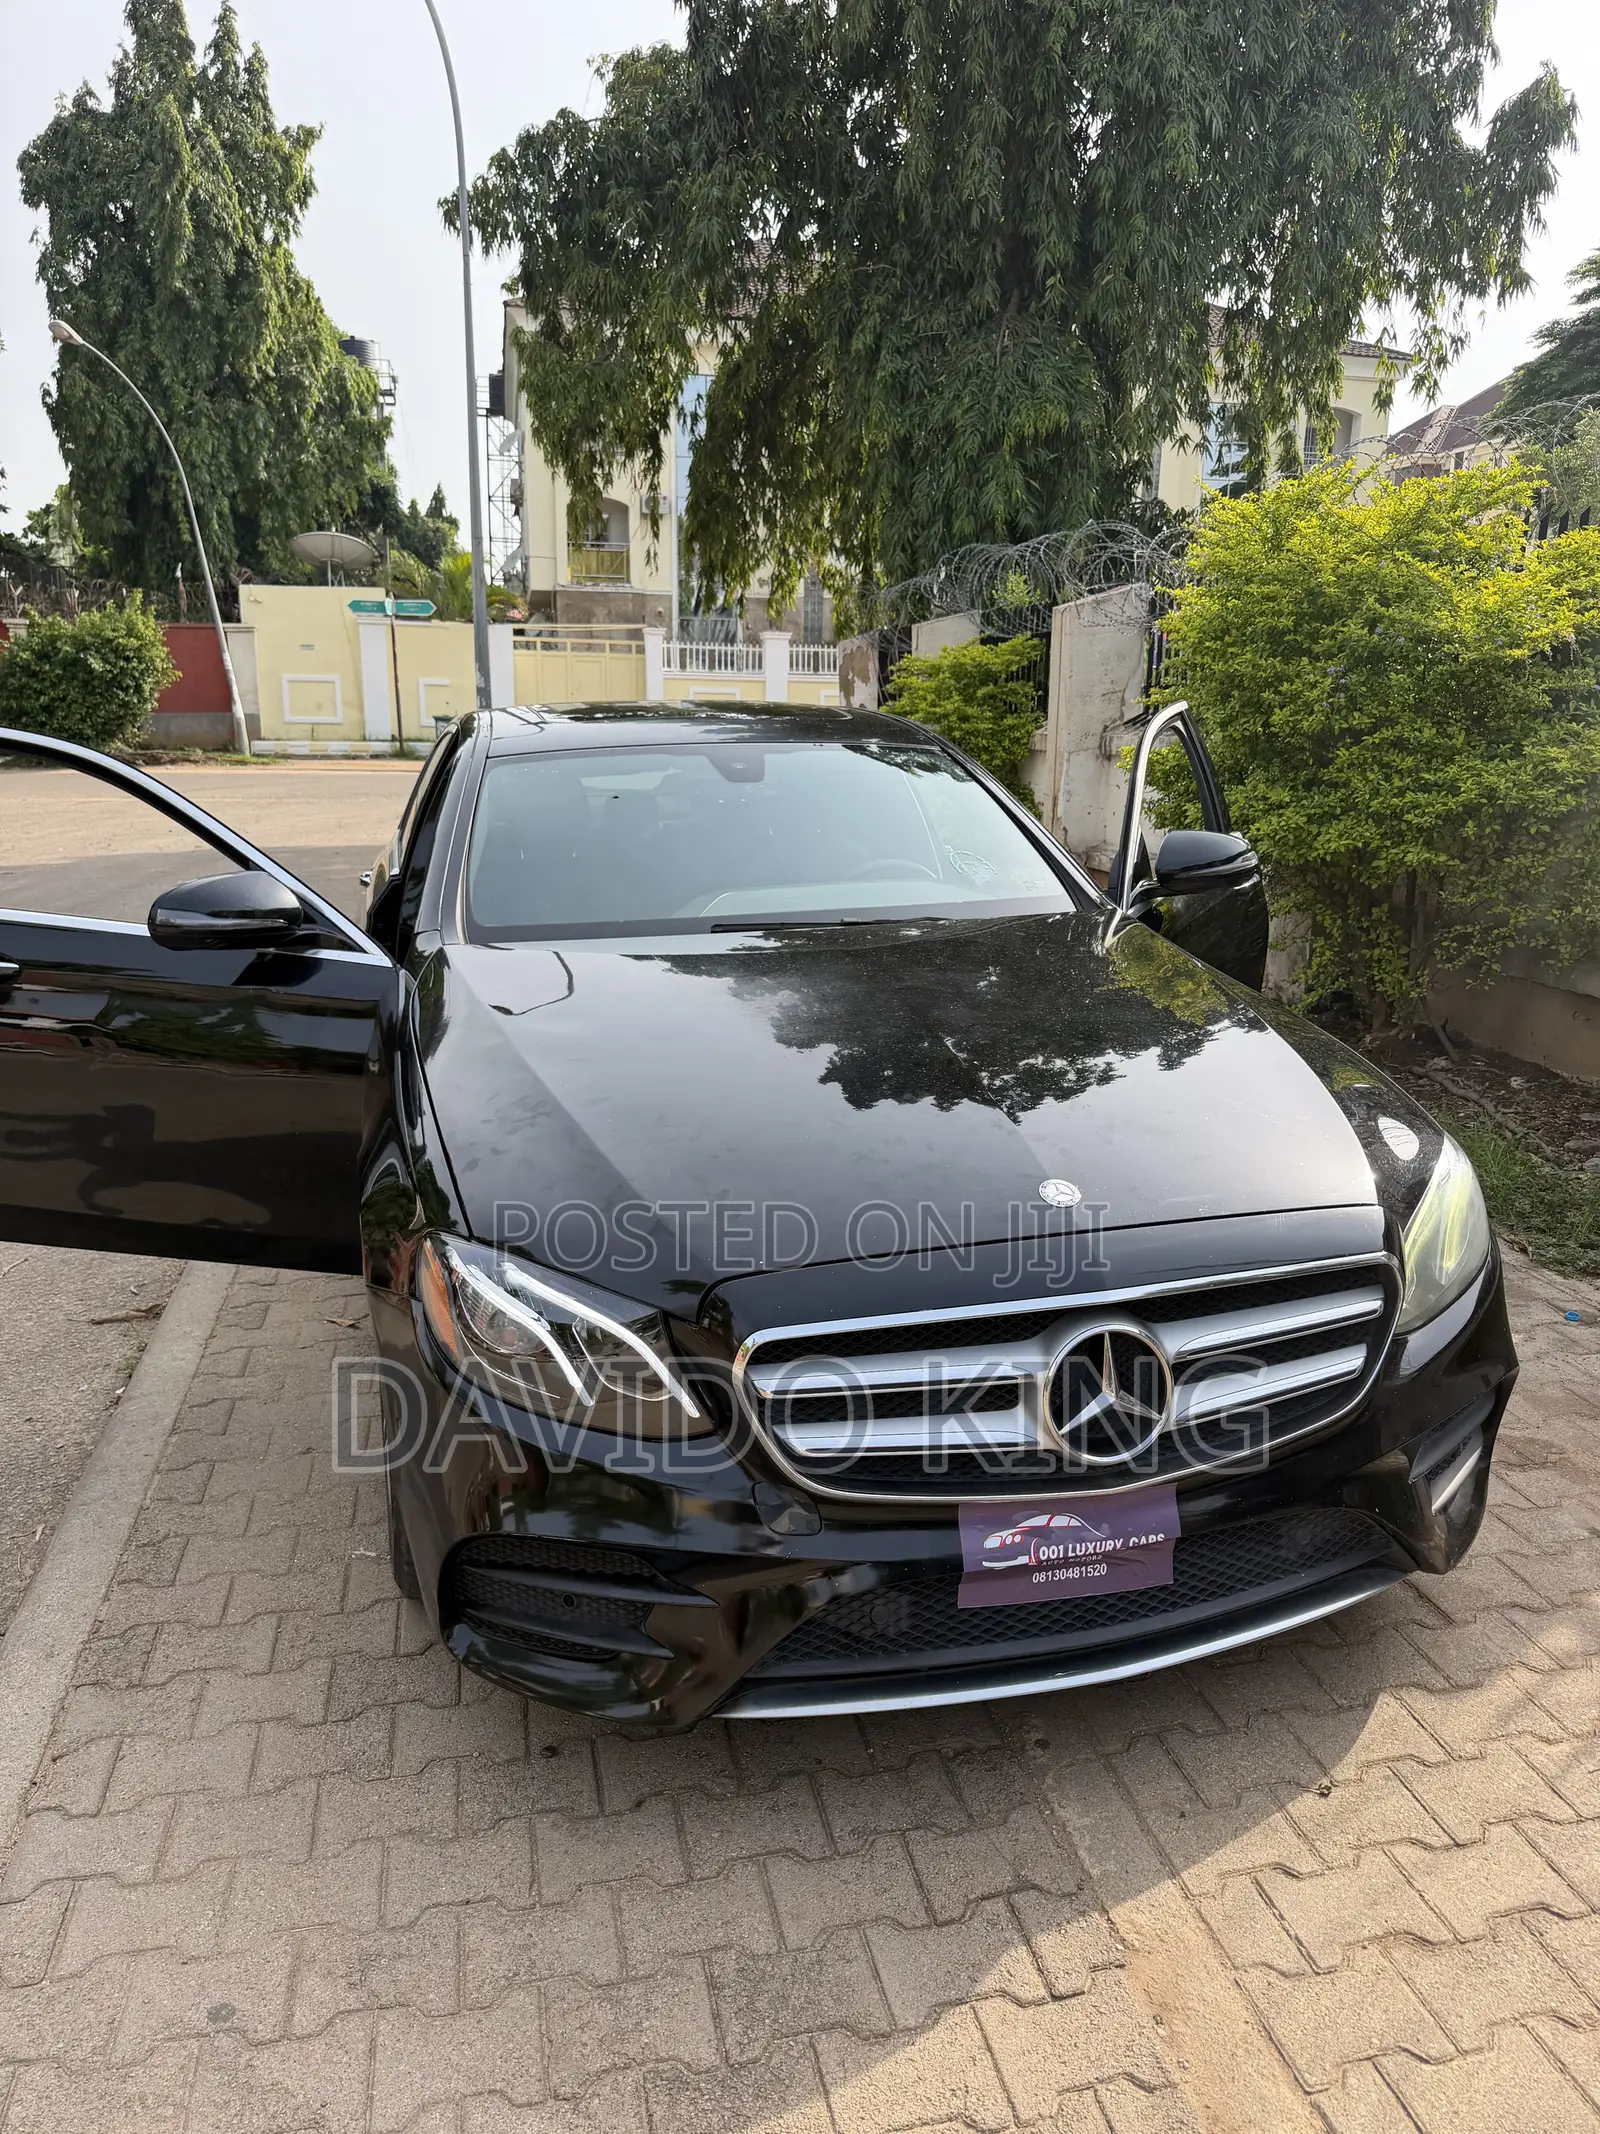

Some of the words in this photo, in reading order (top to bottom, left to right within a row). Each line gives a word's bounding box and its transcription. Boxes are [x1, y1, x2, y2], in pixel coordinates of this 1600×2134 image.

[1039, 1544, 1064, 1561] 001
[1068, 1538, 1123, 1557] LUXURY
[1032, 1563, 1107, 1583] 08130481520
